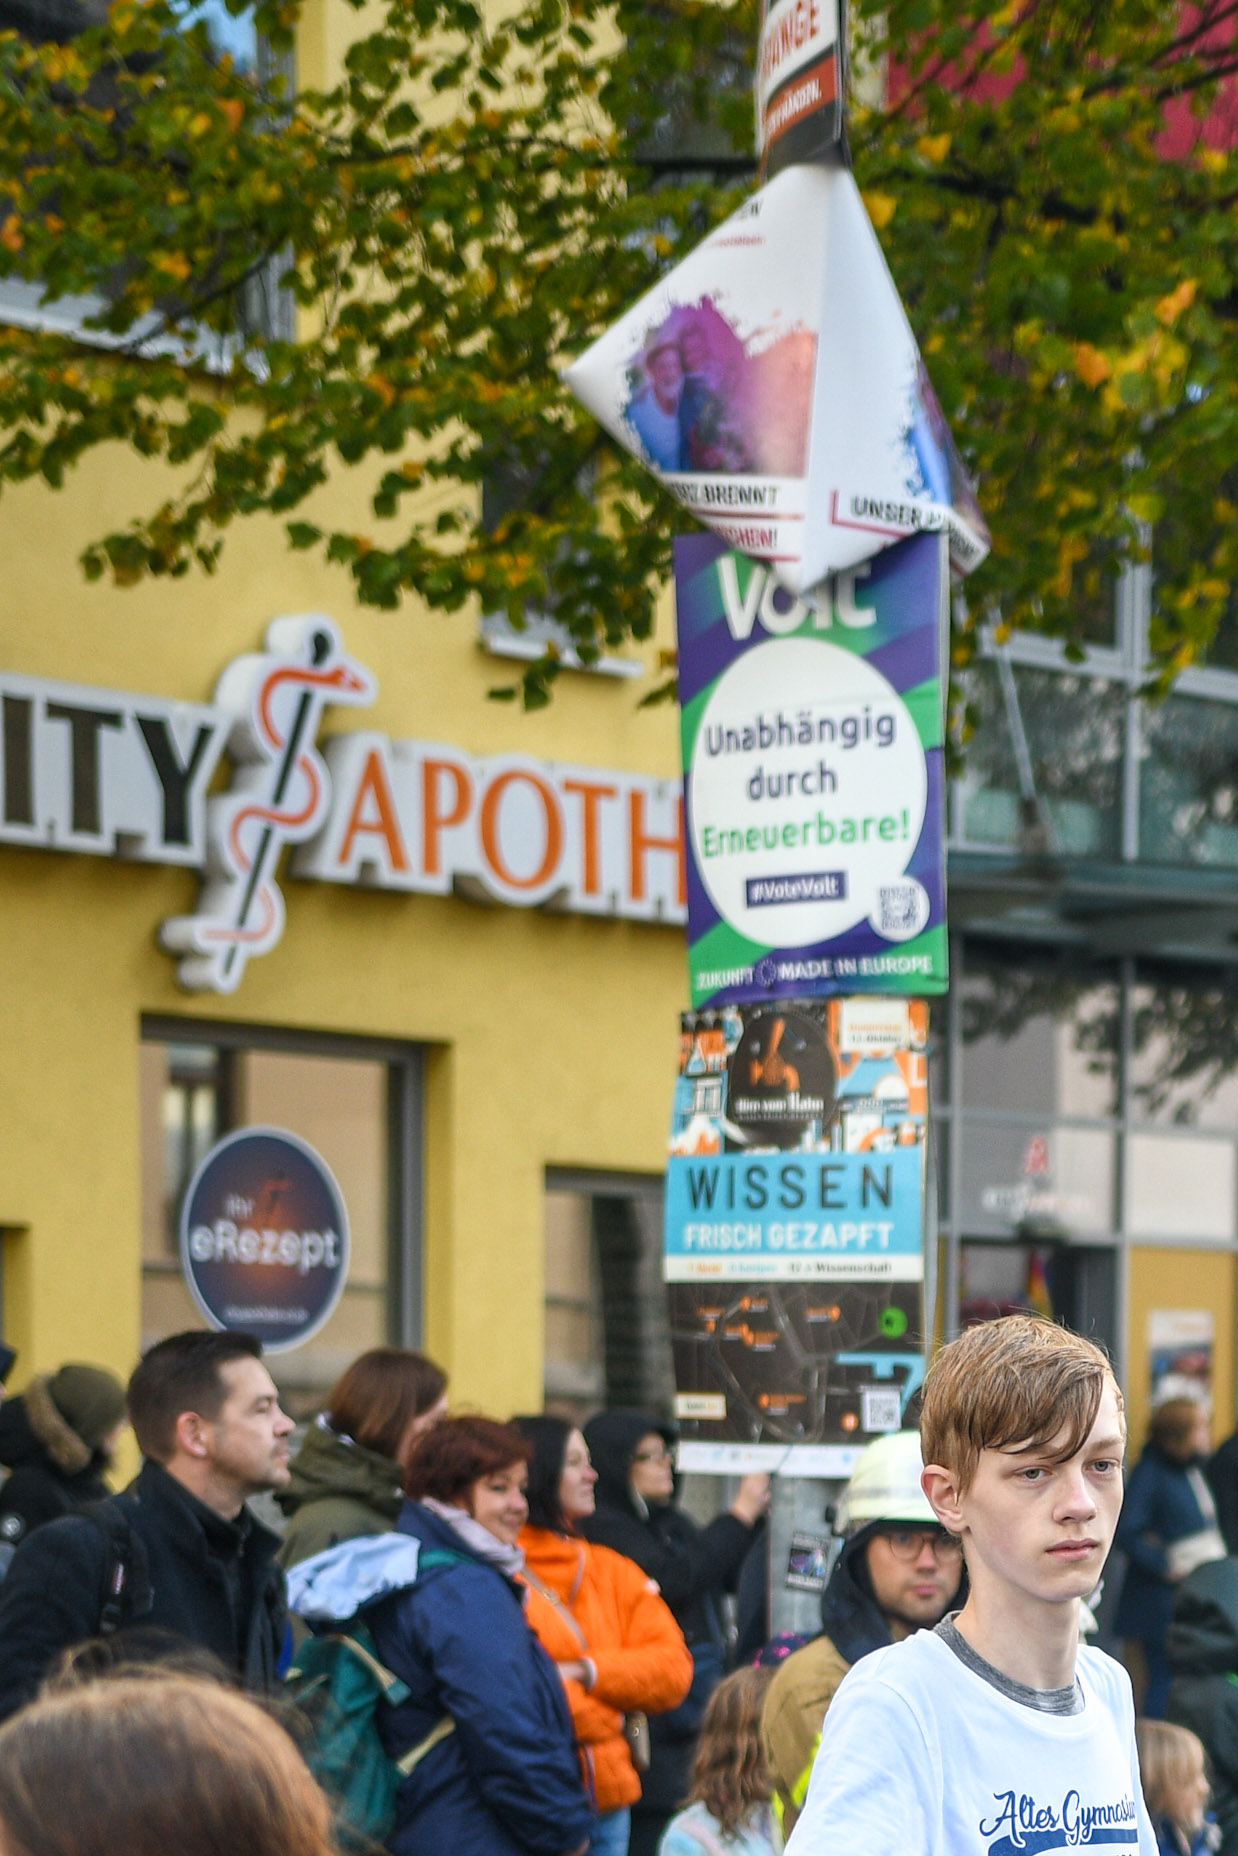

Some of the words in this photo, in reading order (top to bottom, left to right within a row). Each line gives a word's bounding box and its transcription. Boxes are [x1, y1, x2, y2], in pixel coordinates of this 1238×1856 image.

[703, 483, 779, 506] BRENNT
[851, 495, 921, 528] UNSER
[706, 704, 897, 757] Unabhängig
[748, 760, 839, 802] durch
[702, 808, 910, 859] Erneuerbare!
[751, 876, 840, 902] #VoteVolt
[697, 966, 755, 990] ZUKUNFT
[776, 960, 834, 981] MADE
[837, 959, 858, 976] IN
[860, 954, 933, 975] EUROPE
[686, 1163, 894, 1211] WISSEN
[190, 1219, 340, 1277] eRezept
[684, 1221, 763, 1250] FRISCH
[766, 1220, 895, 1250] GEZAPFT
[979, 1790, 1060, 1847] Altes
